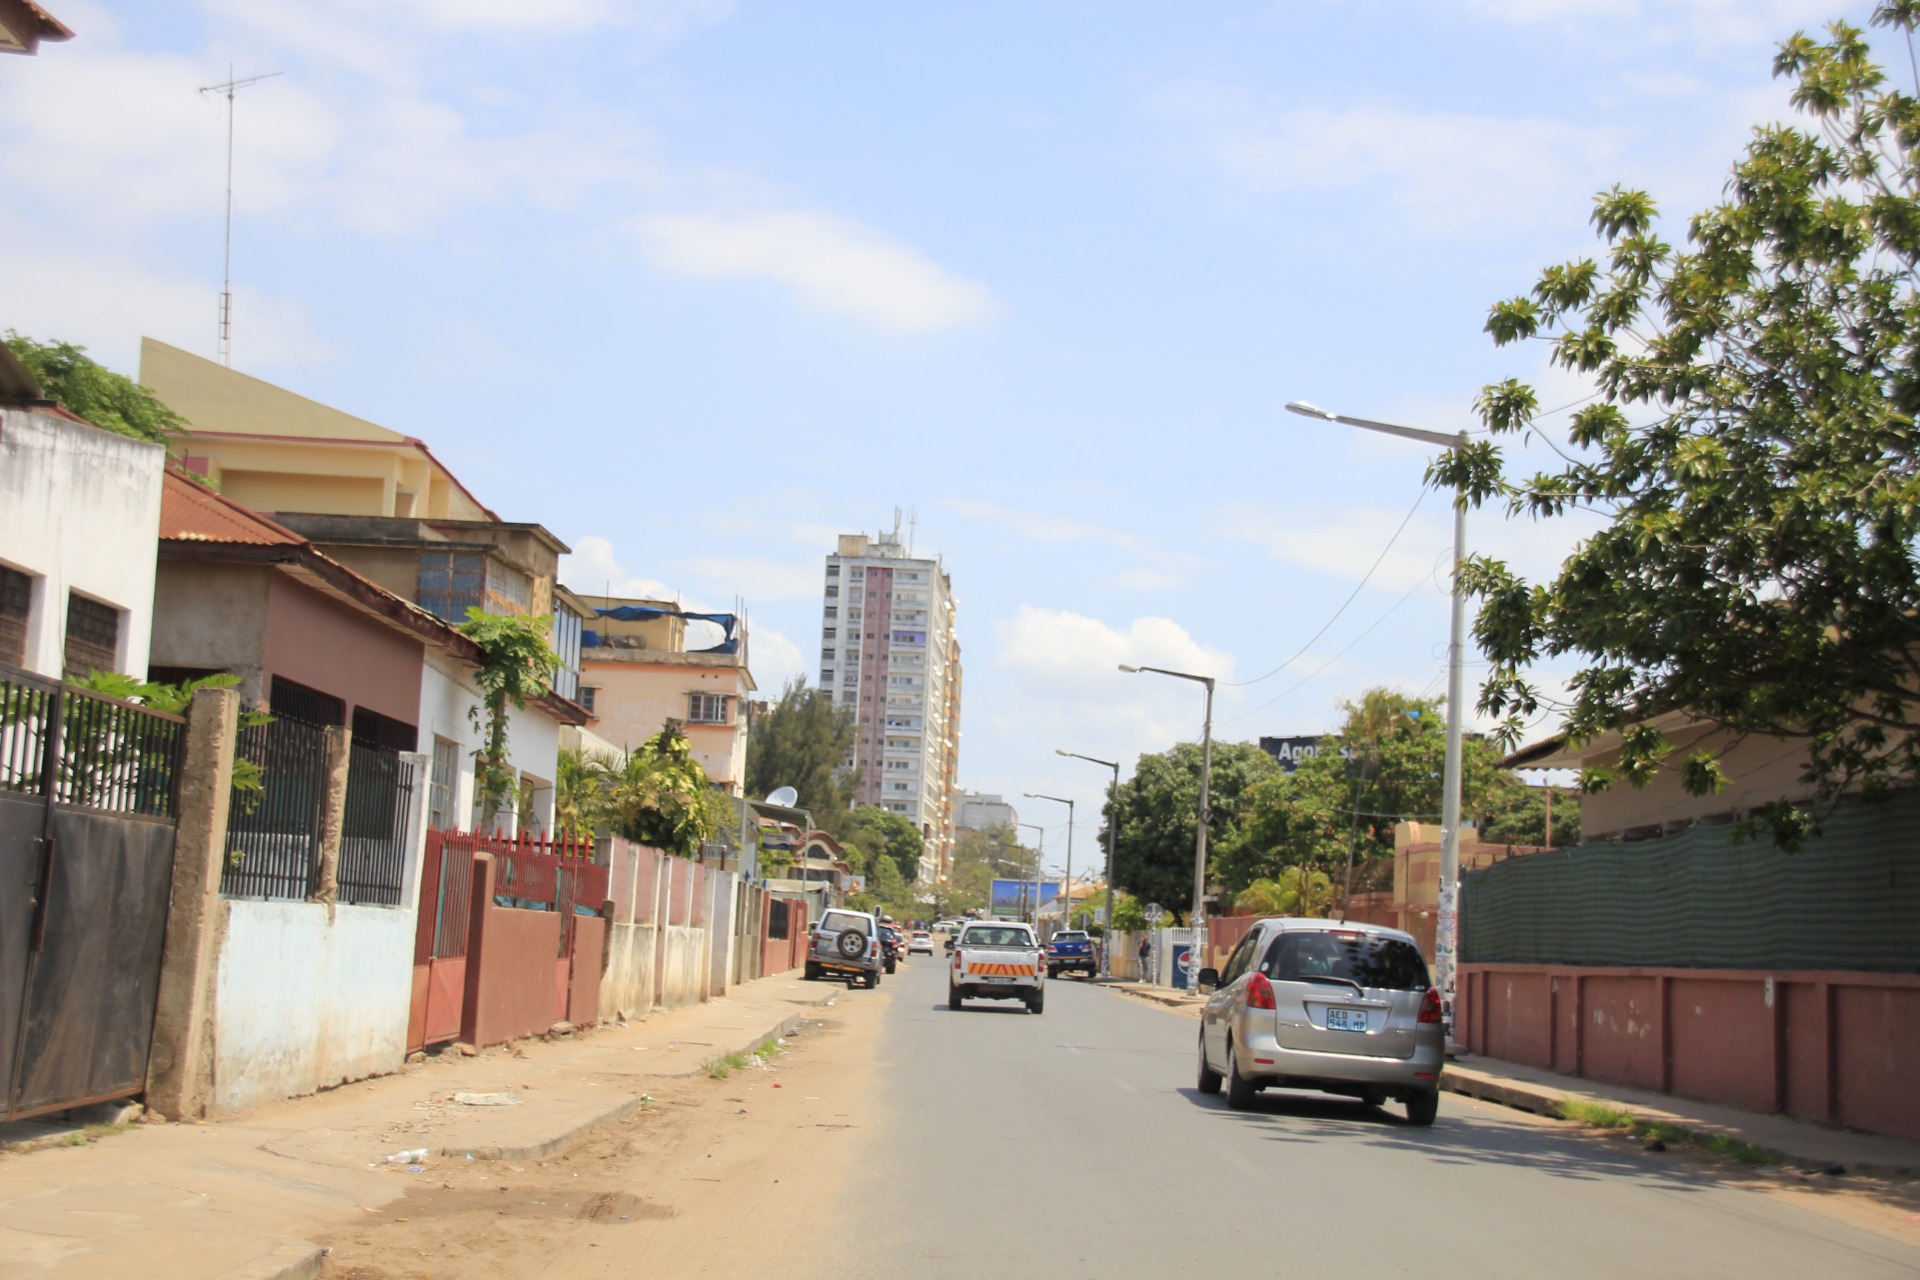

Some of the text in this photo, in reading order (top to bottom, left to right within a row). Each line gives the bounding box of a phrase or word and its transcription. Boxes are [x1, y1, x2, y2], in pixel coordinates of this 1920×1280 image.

[1278, 742, 1334, 765] Agor
[1330, 1010, 1348, 1019] AED
[1353, 1021, 1365, 1029] MP
